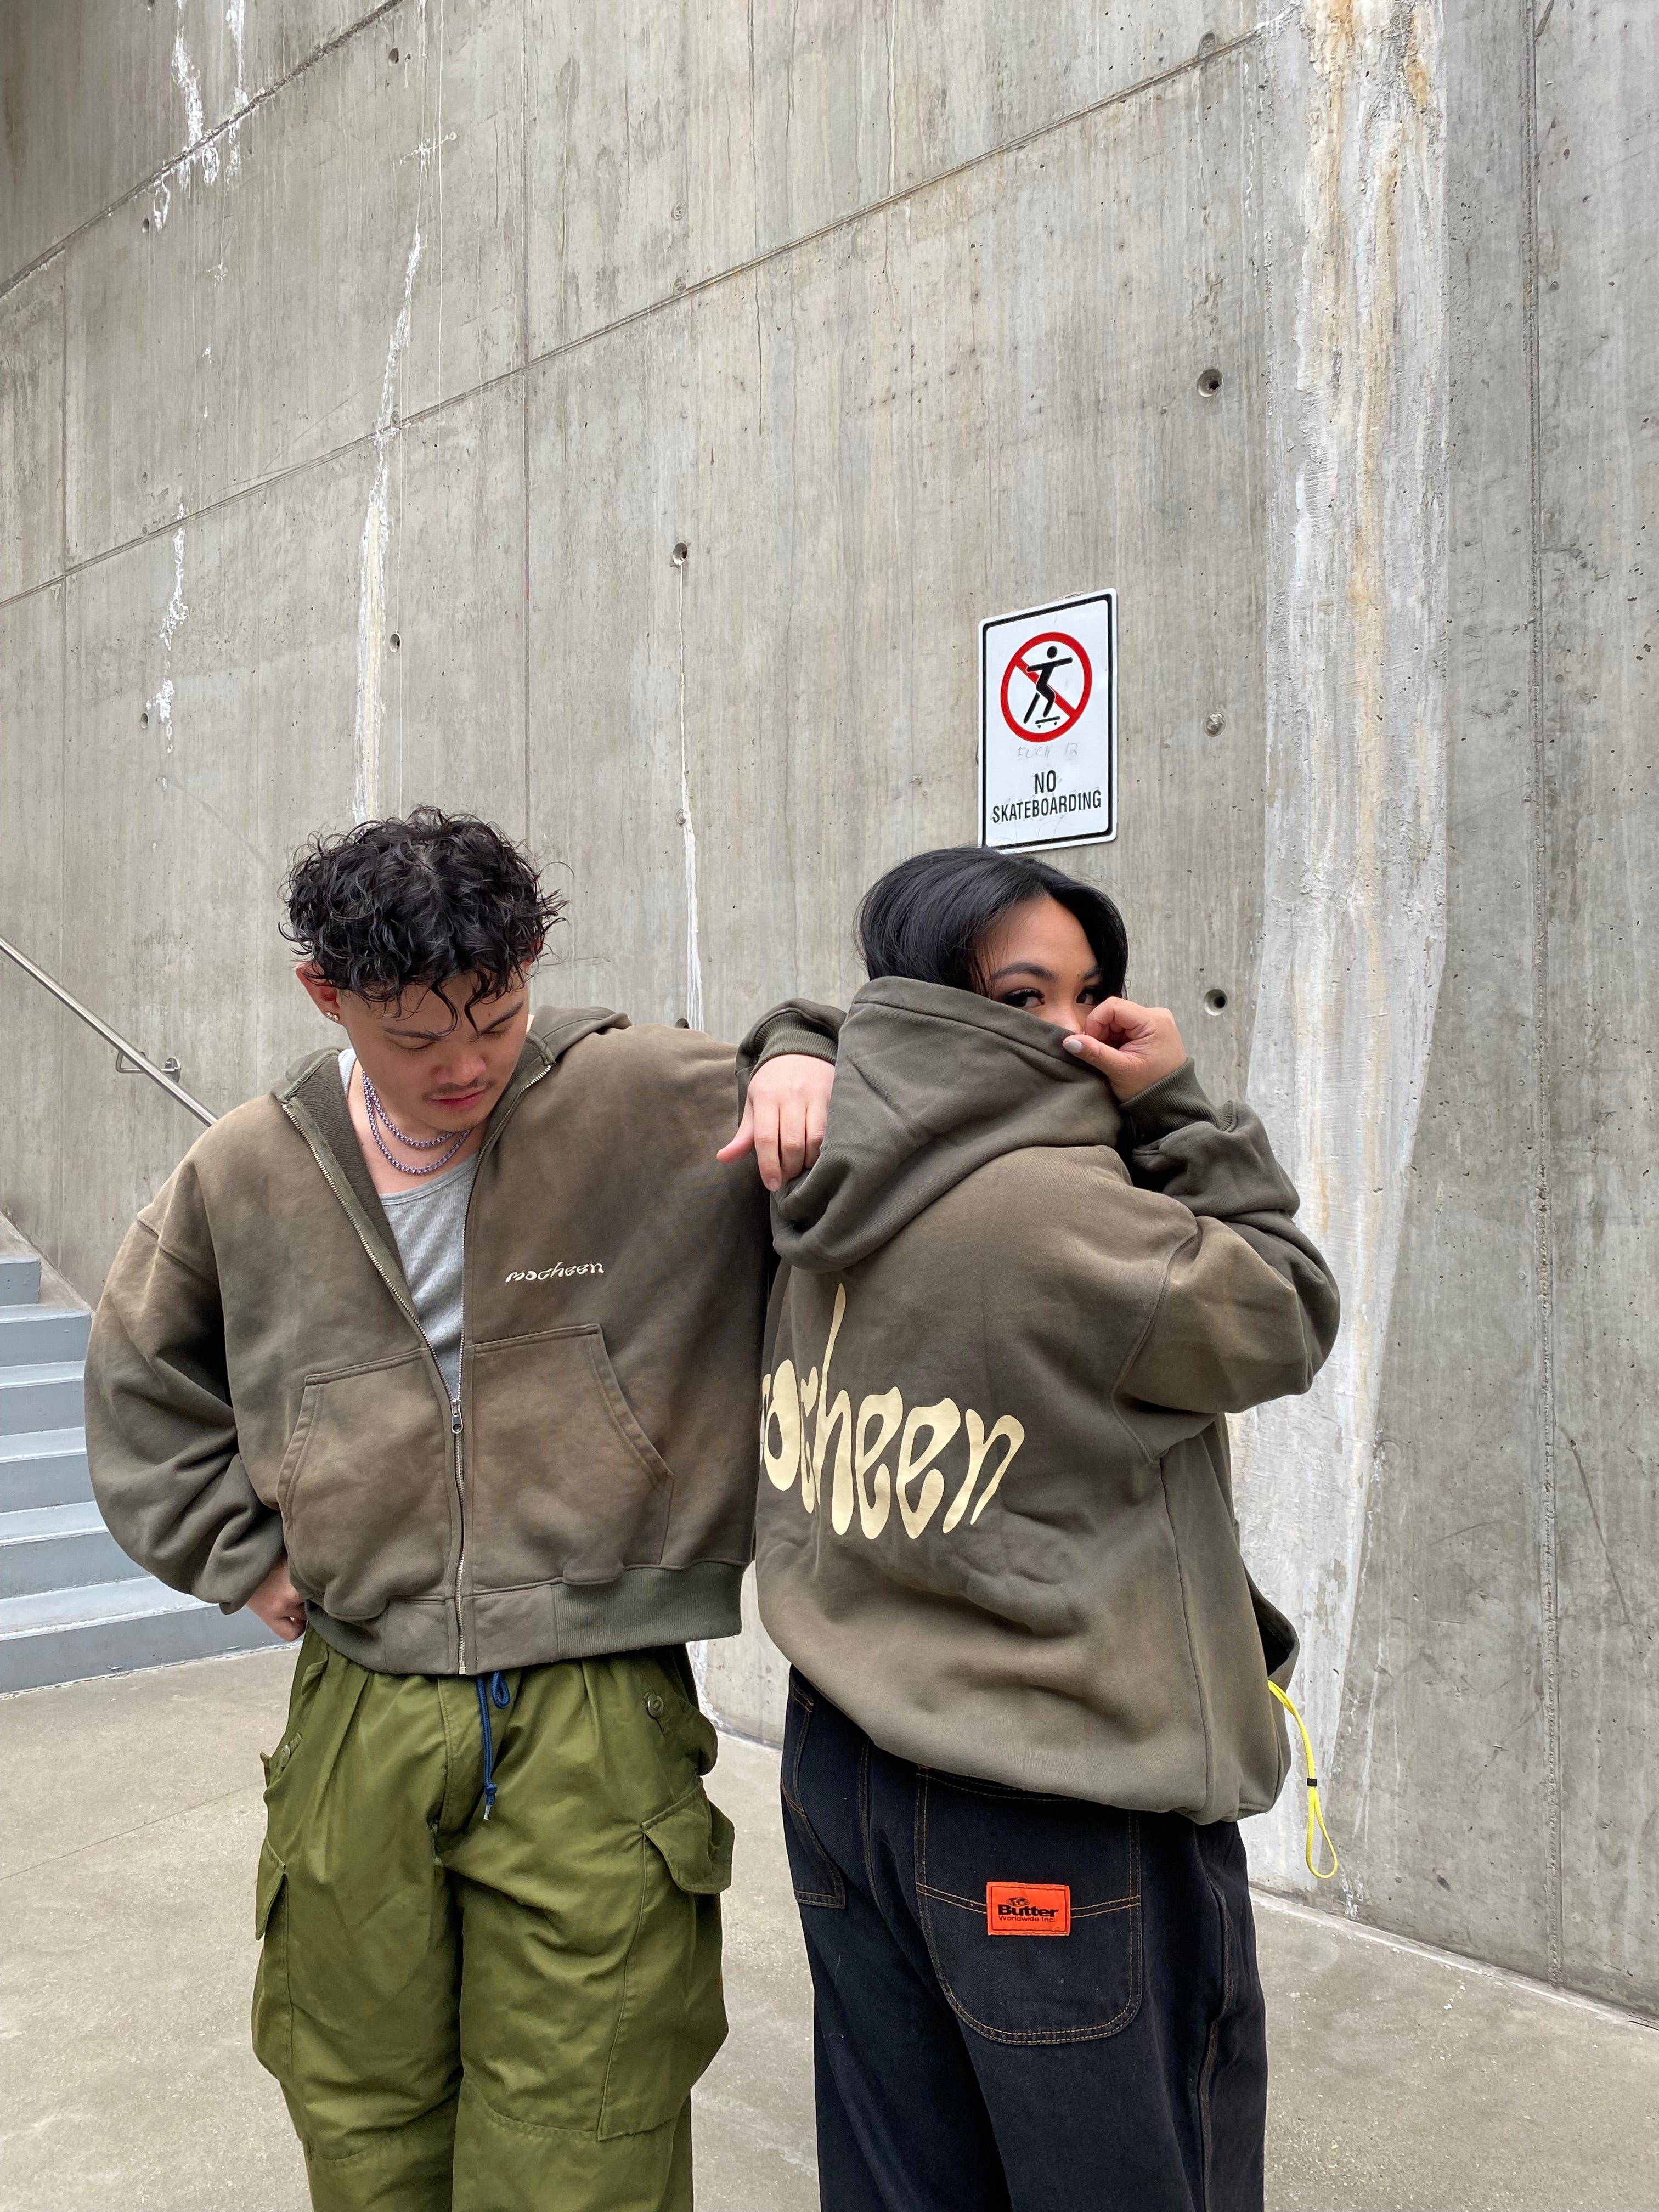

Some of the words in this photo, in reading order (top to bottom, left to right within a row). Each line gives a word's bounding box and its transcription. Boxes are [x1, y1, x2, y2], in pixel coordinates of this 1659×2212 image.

[1034, 770, 1057, 795] NO
[992, 789, 1101, 823] SKATEBOARDING
[761, 1283, 1025, 1539] ocheen
[997, 1904, 1059, 1917] Butter
